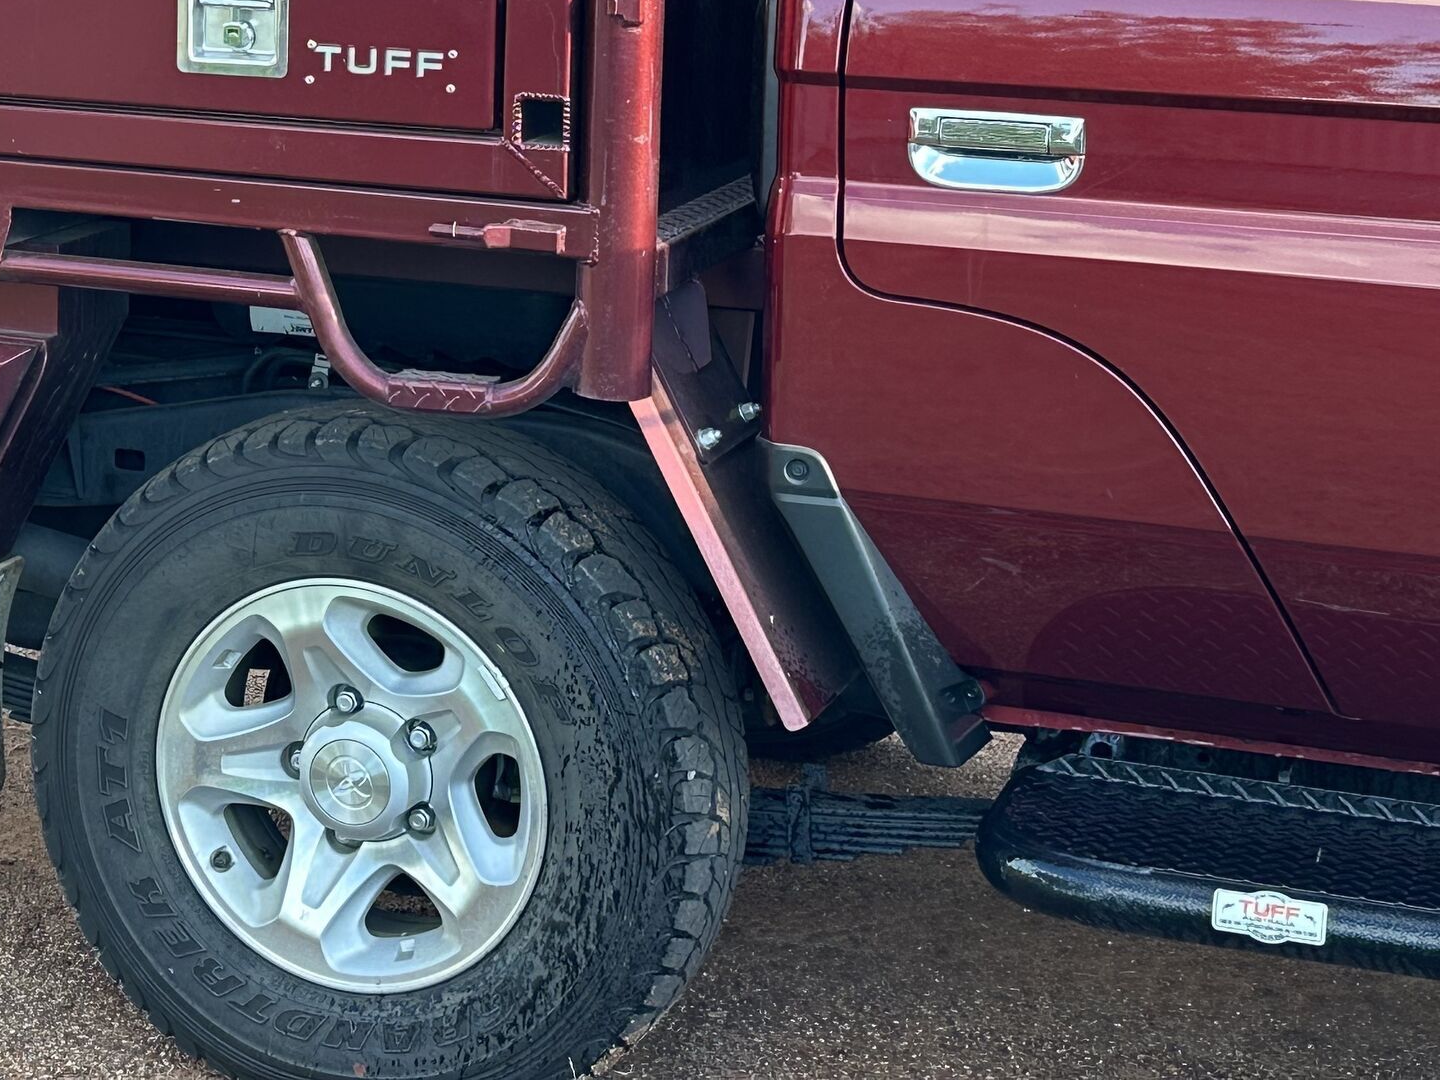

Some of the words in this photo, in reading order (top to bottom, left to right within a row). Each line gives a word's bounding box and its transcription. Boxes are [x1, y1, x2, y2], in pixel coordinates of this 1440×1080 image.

[315, 44, 444, 78] TUFF
[285, 531, 578, 726] DUNLOP
[96, 705, 143, 854] AT1
[1238, 899, 1301, 921] TUFF
